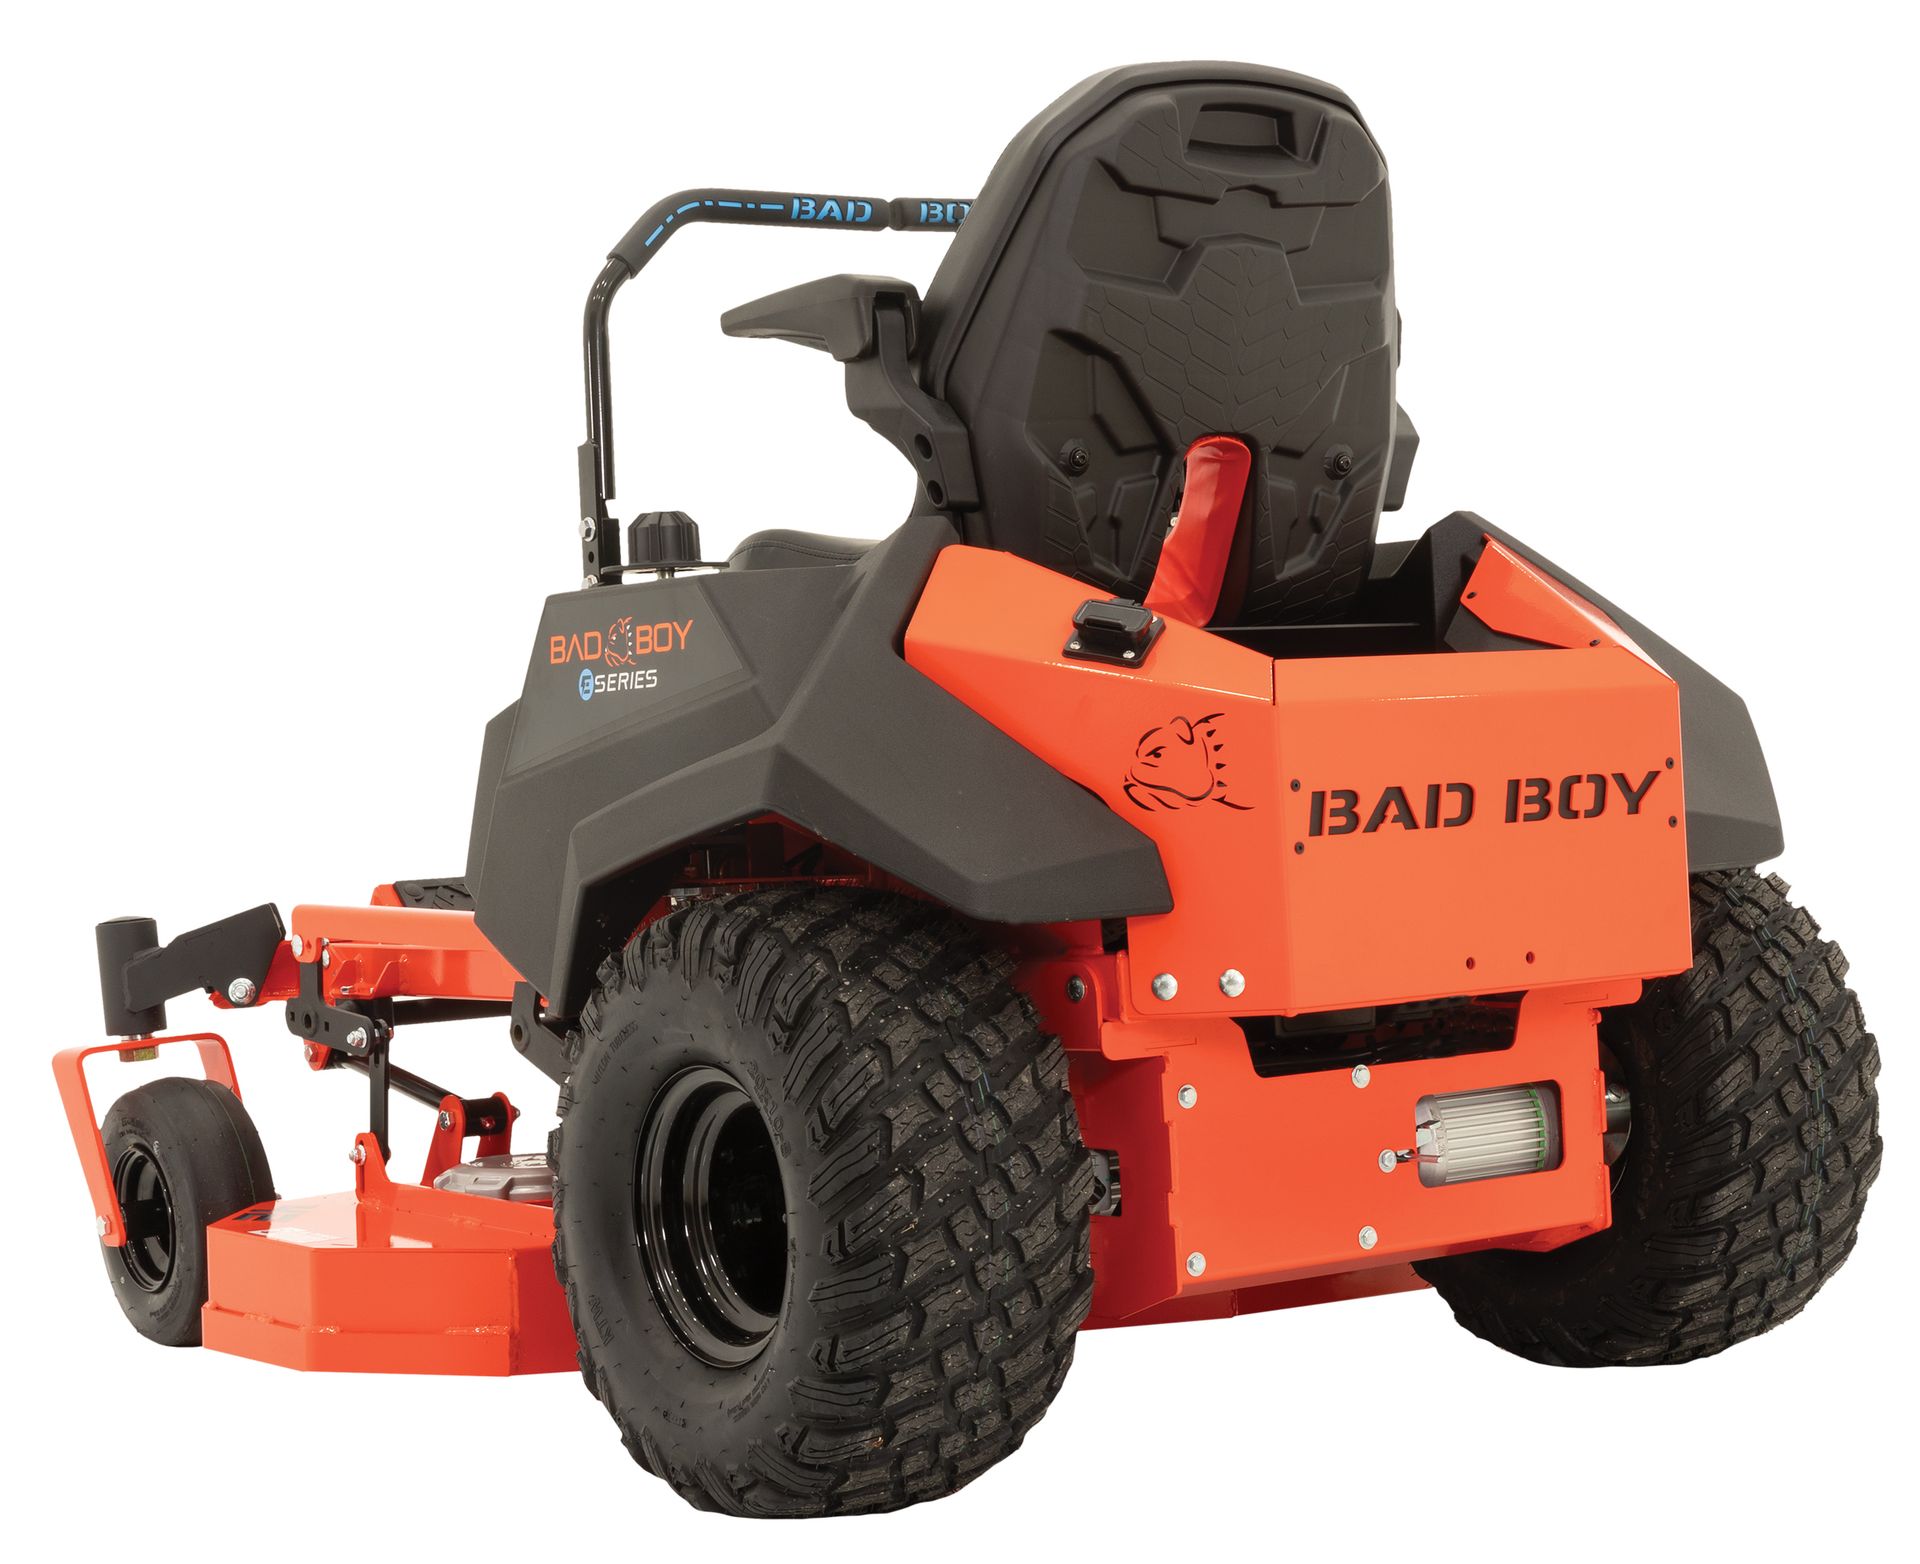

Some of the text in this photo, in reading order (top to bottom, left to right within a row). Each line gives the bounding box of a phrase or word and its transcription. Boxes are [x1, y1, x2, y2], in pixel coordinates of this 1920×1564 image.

[791, 197, 873, 222] BAD
[549, 619, 694, 665] BAD BOY
[594, 669, 658, 693] SERIES
[1308, 770, 1661, 837] BAD BOY
